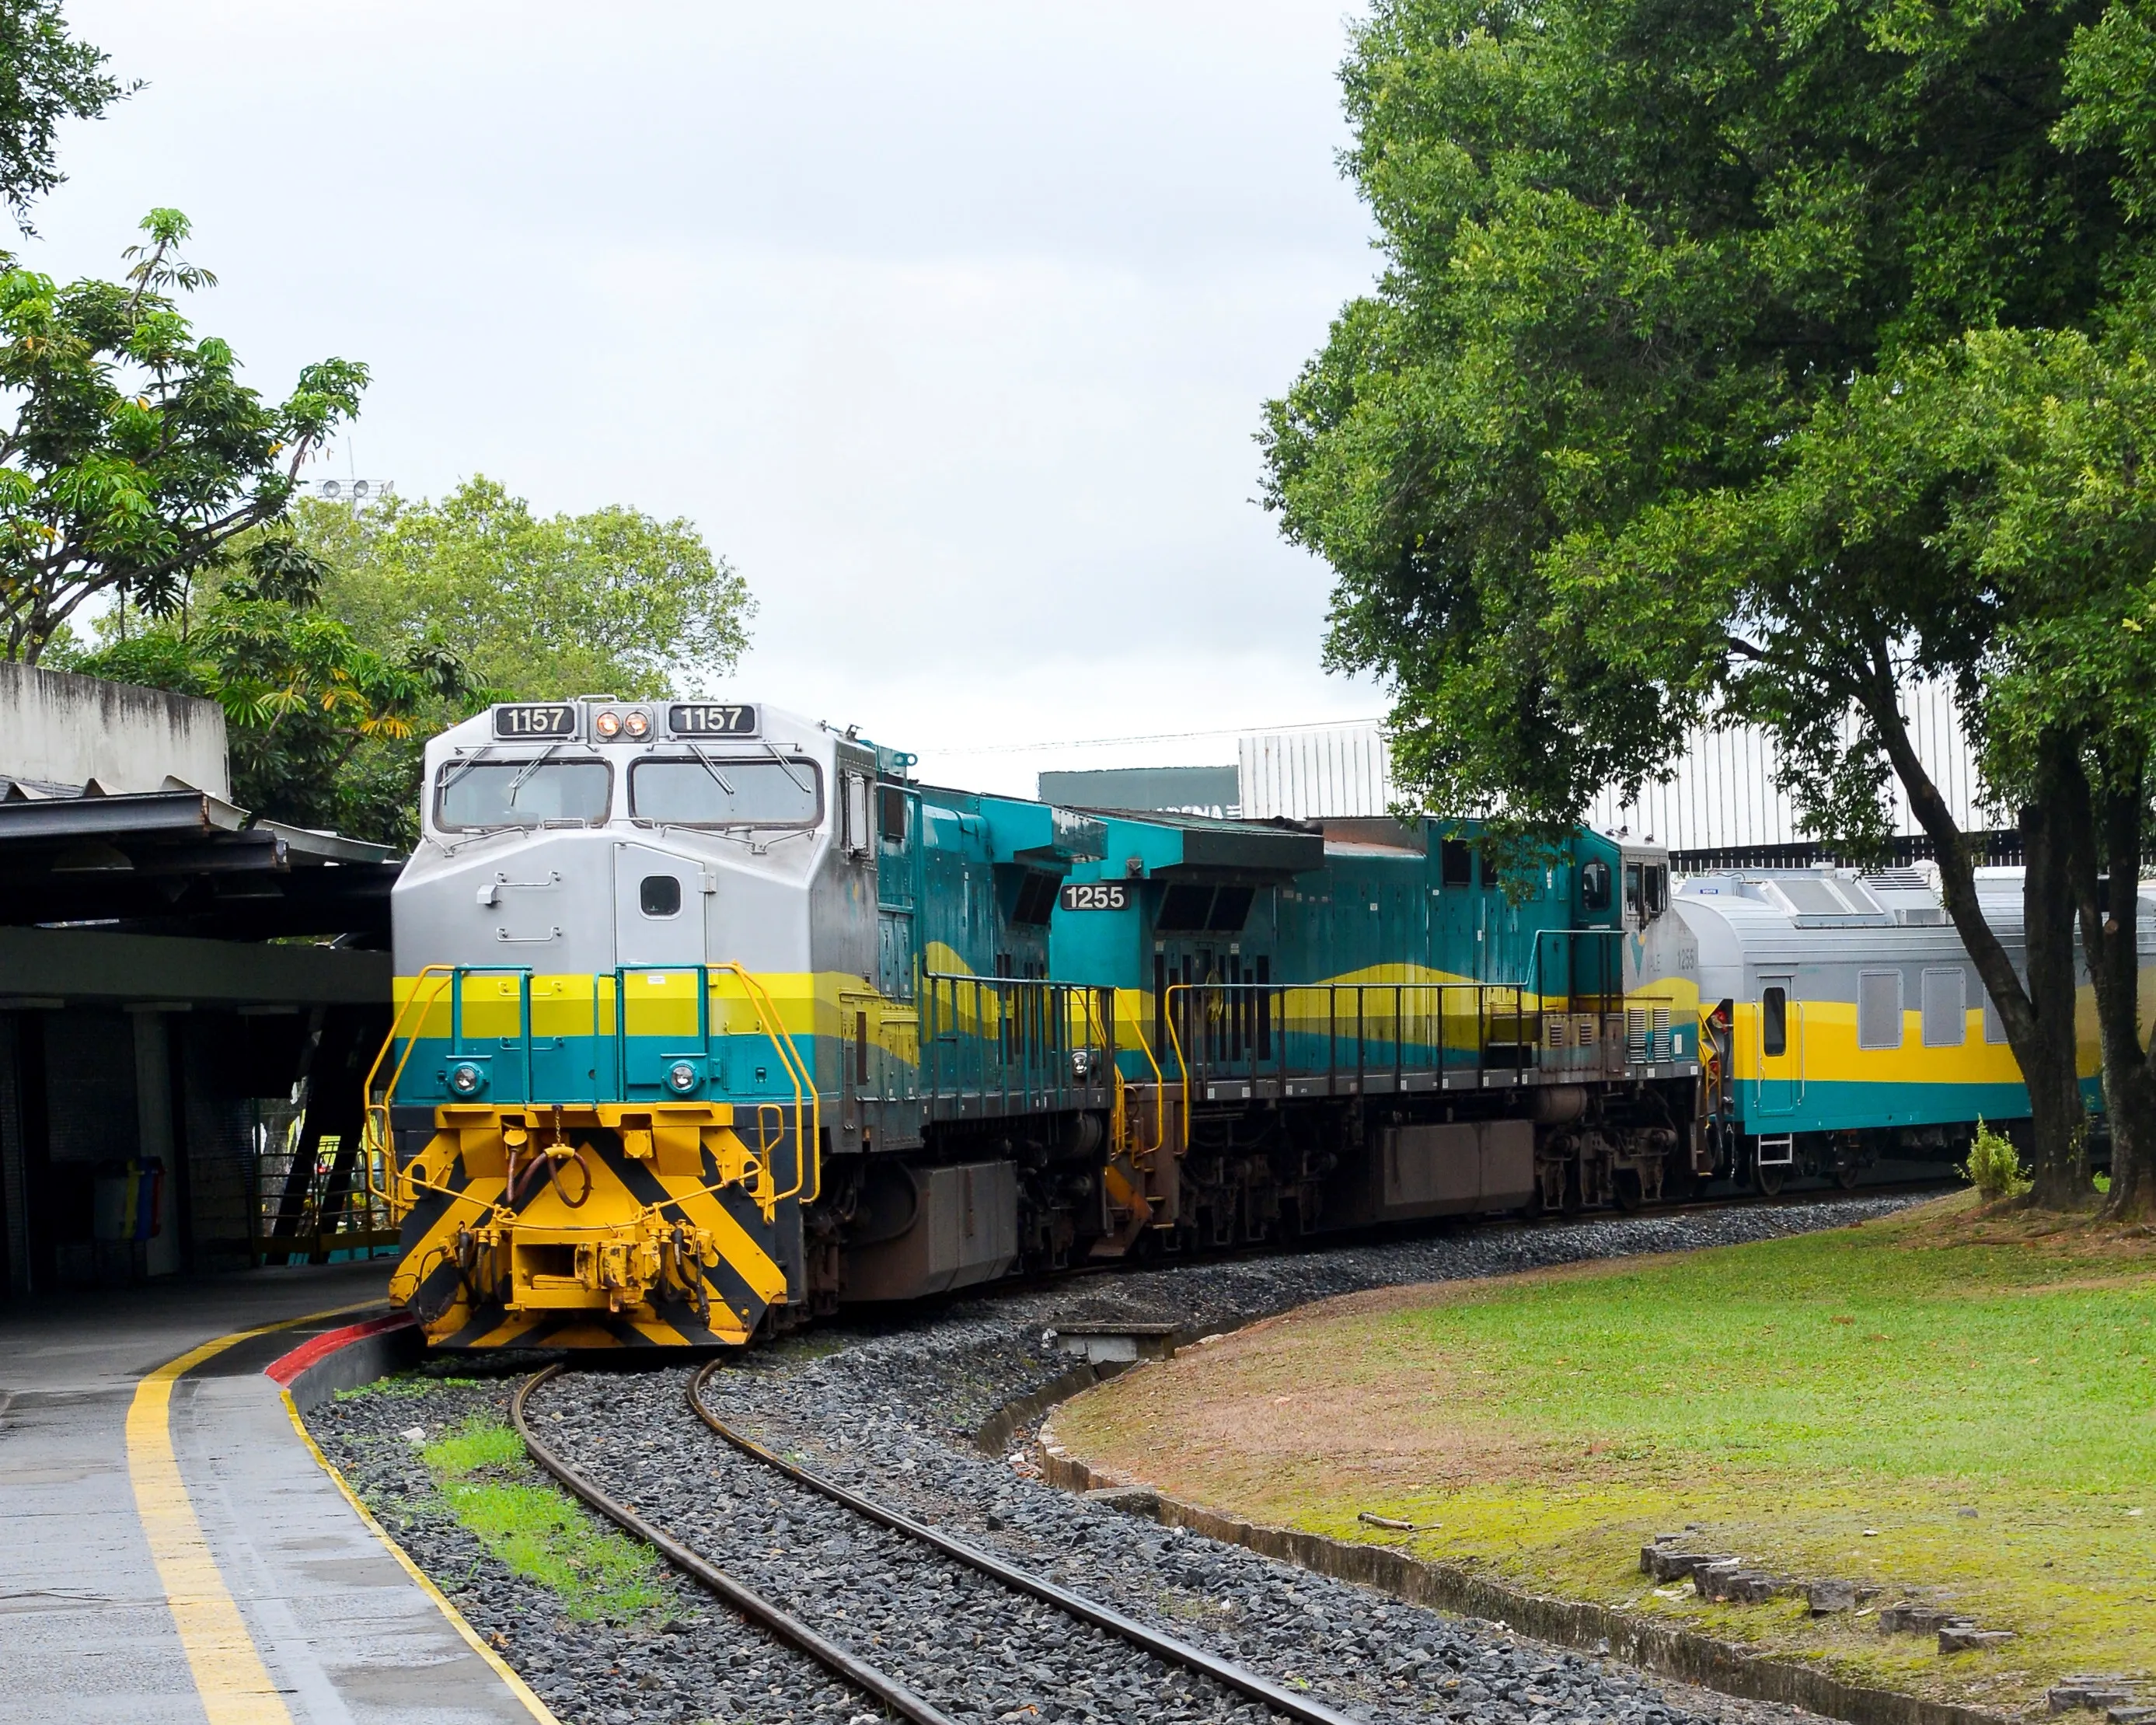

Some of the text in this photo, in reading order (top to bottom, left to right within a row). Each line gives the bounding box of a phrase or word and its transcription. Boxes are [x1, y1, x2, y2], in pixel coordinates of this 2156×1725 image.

[508, 708, 565, 732] 1157
[681, 707, 742, 731] 1157
[1066, 886, 1125, 909] 1255
[1678, 948, 1694, 970] 1255
